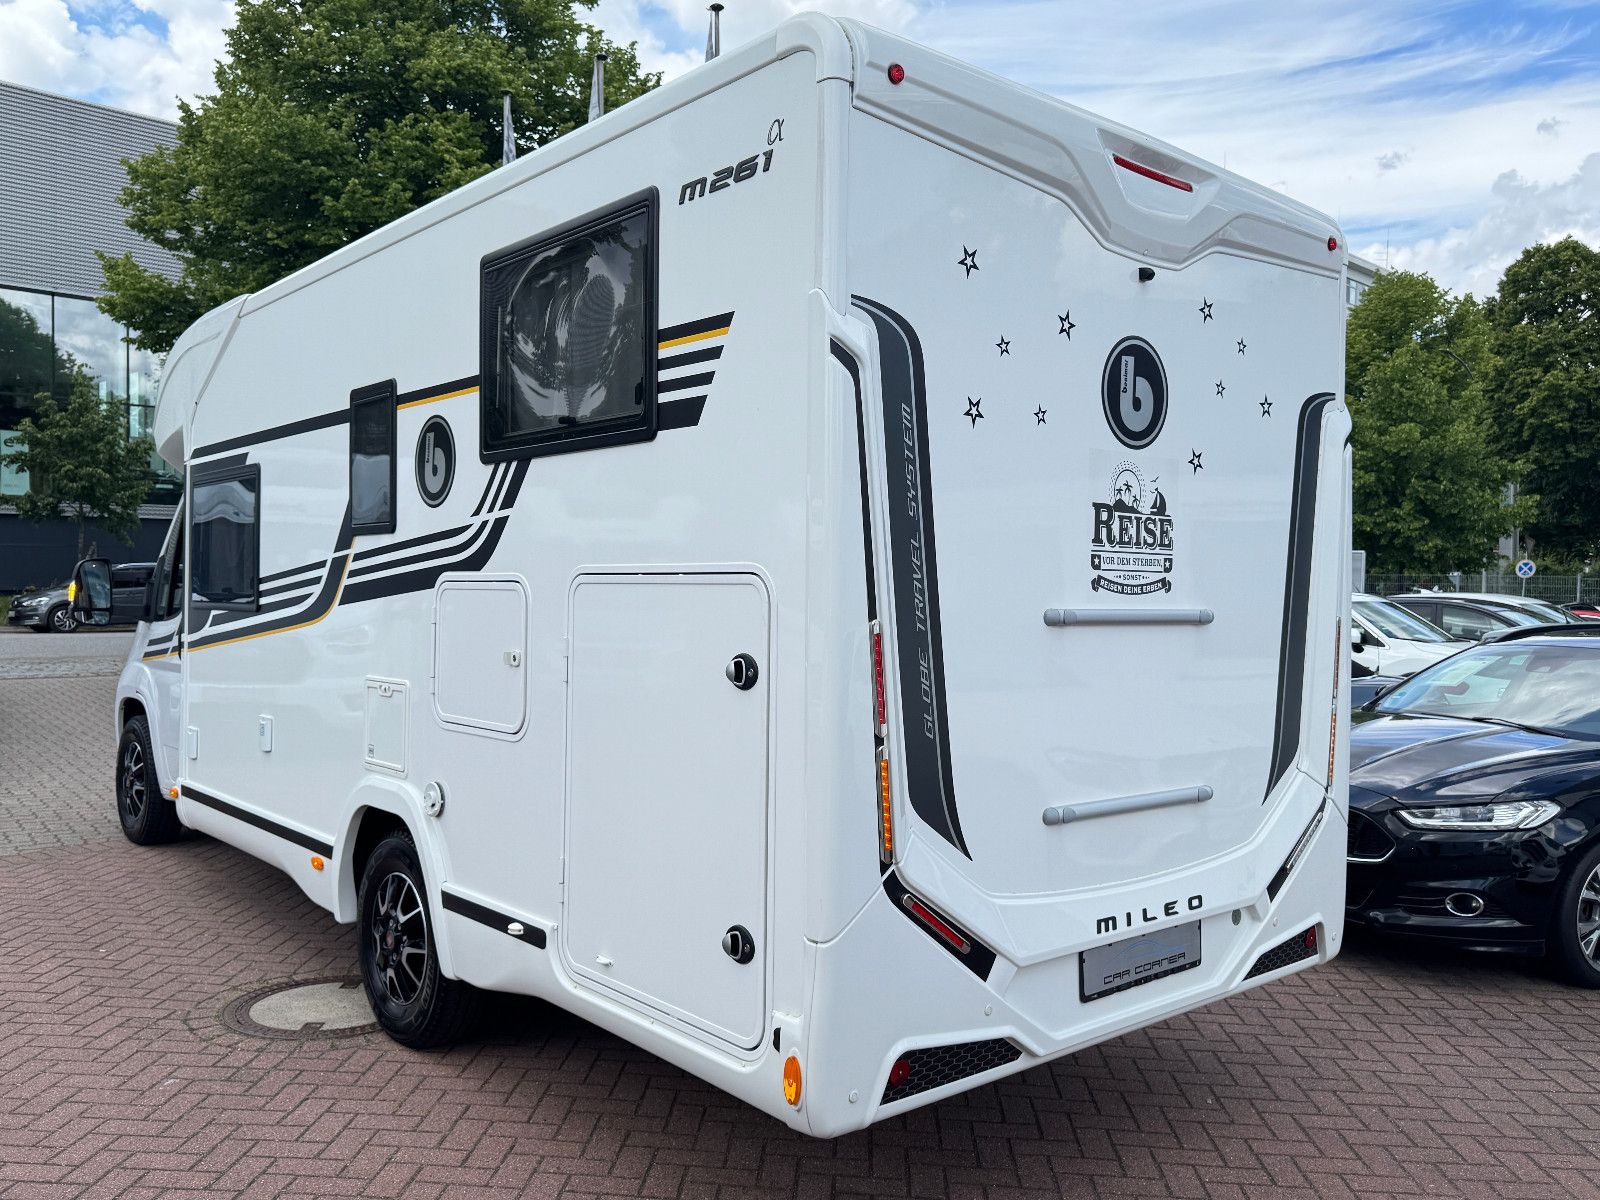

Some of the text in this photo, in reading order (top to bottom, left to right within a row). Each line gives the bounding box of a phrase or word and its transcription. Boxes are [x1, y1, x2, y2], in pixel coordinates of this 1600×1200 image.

[1091, 501, 1174, 551] REISE
[901, 402, 934, 740] GLOBE TRAVEL SYSTEM
[1102, 556, 1115, 566] VOR
[1116, 557, 1131, 567] DEM
[1122, 573, 1142, 581] SONST
[1100, 579, 1162, 594] REISEN DEINE ERBEN
[1096, 894, 1203, 934] MILEO
[1103, 951, 1186, 985] CAR CORNER
